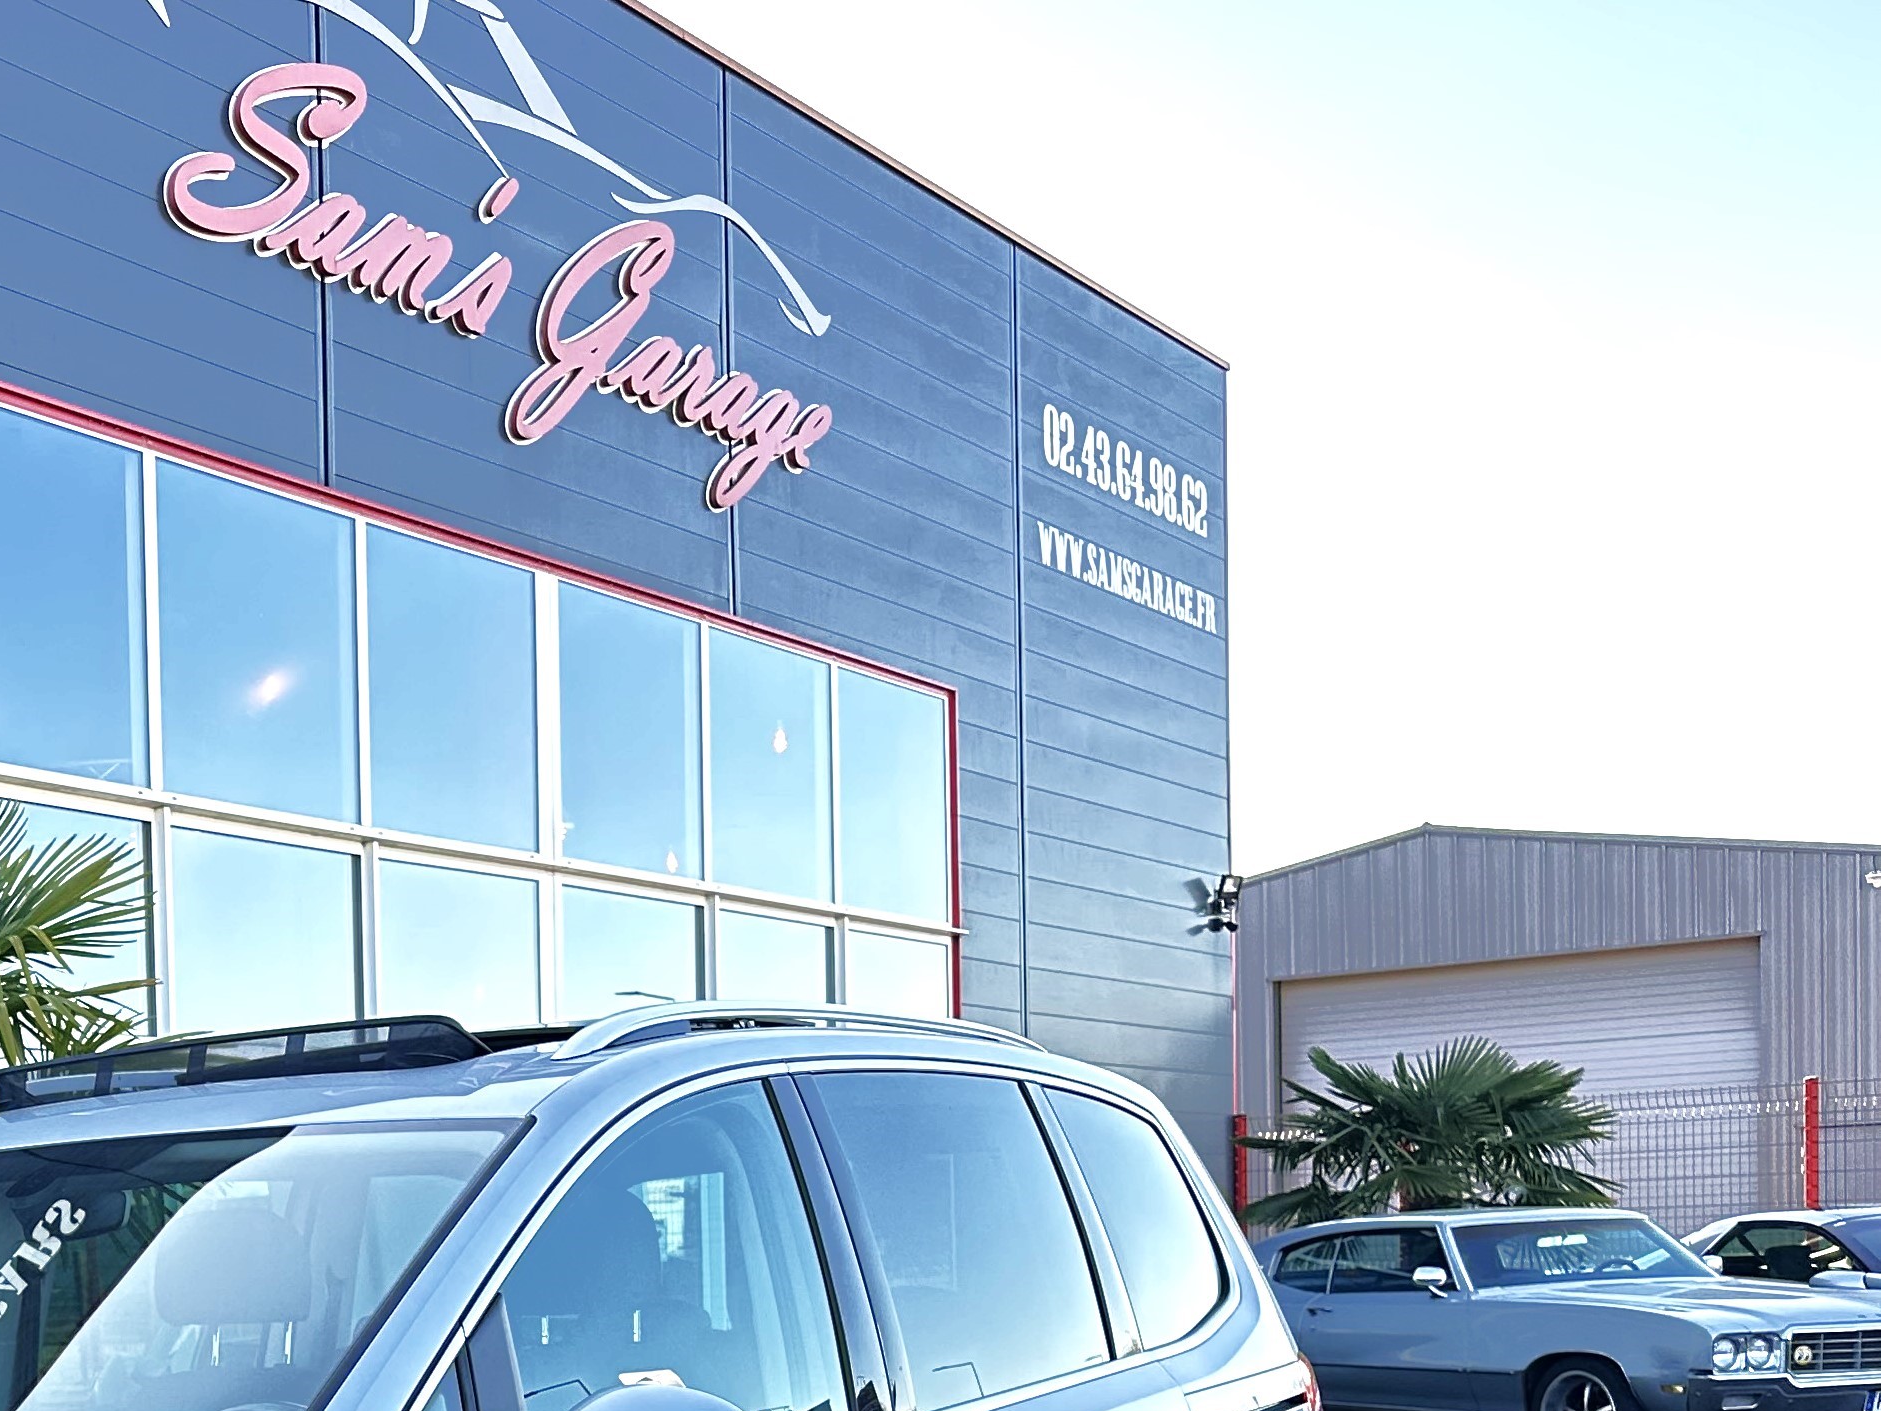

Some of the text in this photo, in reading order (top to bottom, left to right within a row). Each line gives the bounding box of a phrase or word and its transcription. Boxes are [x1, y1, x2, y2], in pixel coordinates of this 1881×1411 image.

[163, 62, 833, 513] Sam's Garage
[1042, 403, 1209, 539] 02.43.64.98.62
[1036, 521, 1217, 635] WWW.SAMSGARAGE.FR
